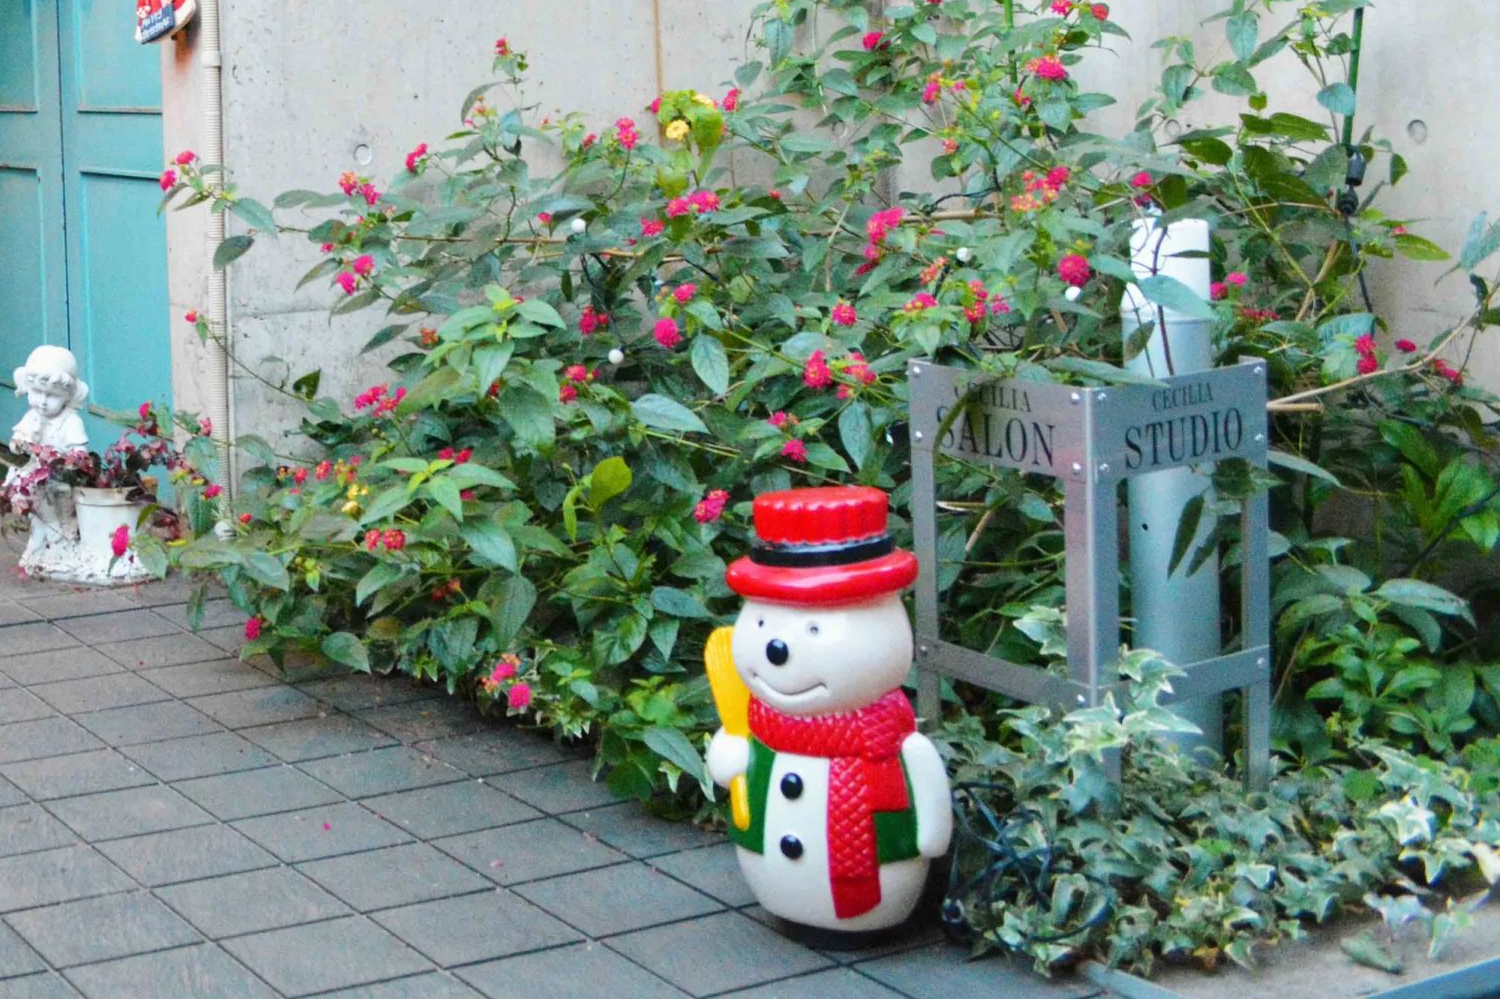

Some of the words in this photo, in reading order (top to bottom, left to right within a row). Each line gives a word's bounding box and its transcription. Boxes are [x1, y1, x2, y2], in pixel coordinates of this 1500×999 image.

[1151, 382, 1214, 412] CECILIA
[936, 405, 1056, 468] SALON
[1124, 407, 1243, 470] STUDIO
